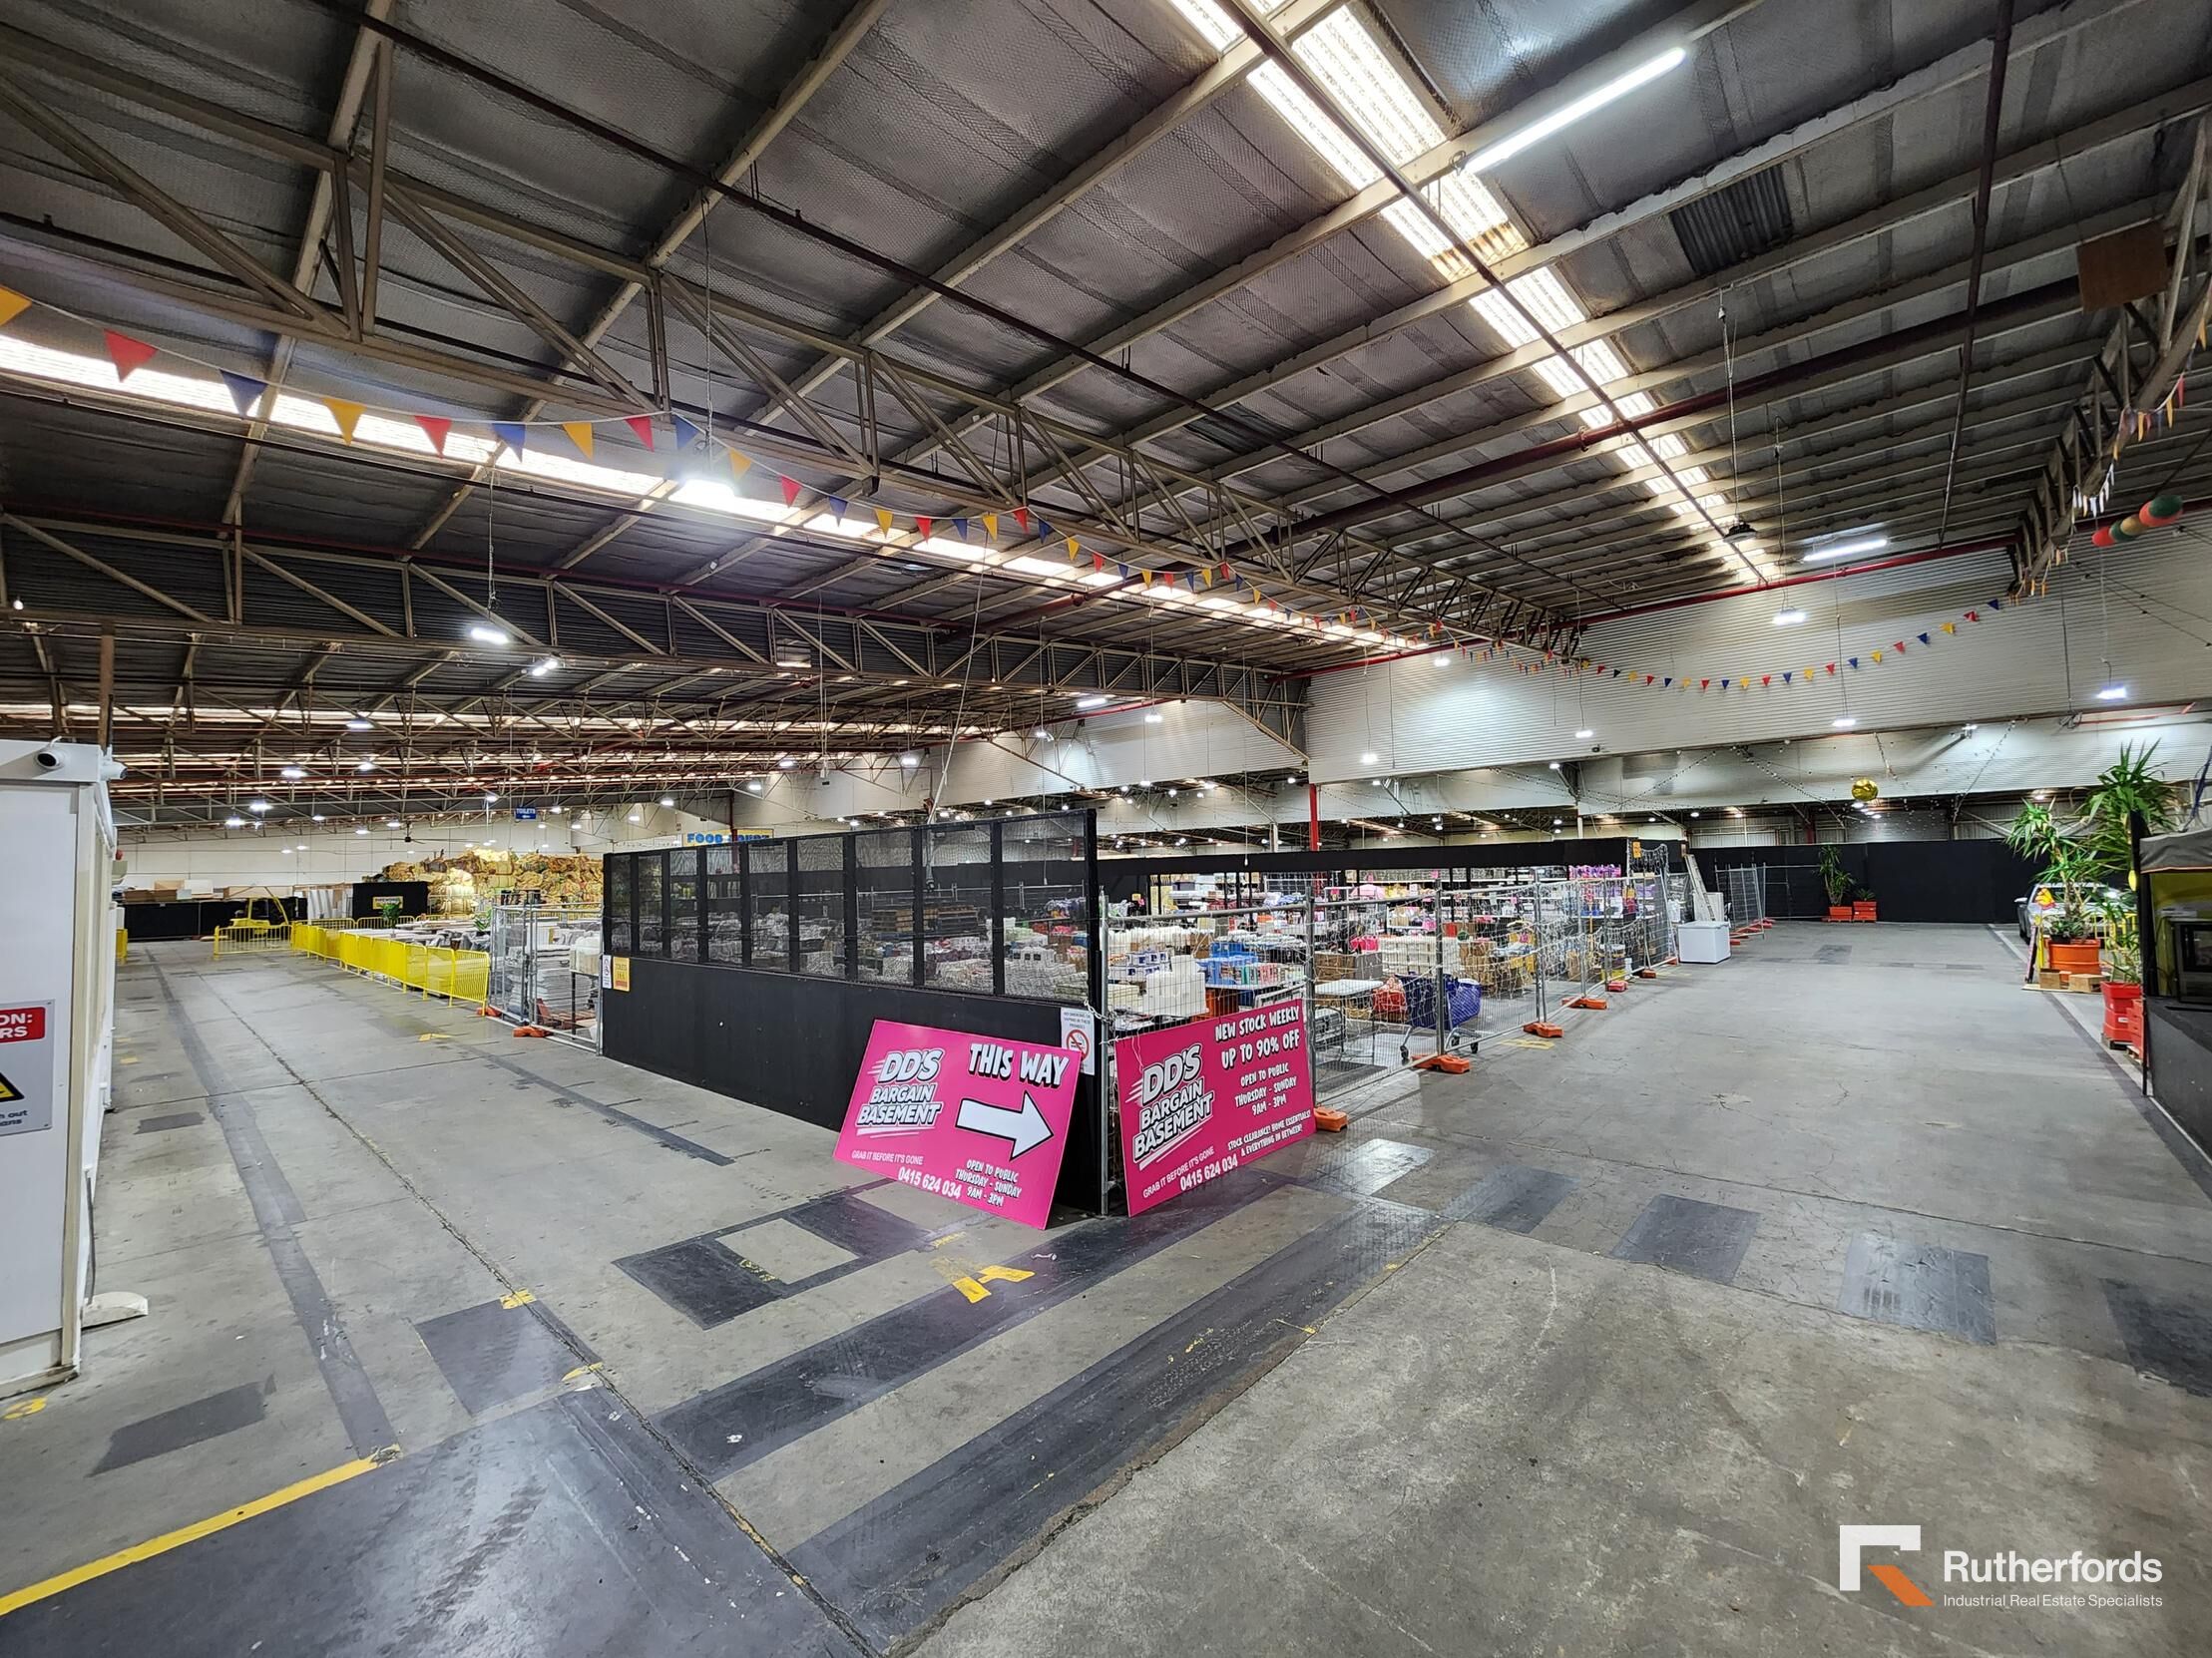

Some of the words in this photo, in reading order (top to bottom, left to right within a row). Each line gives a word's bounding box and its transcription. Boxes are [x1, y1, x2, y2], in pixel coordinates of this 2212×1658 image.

[686, 832, 723, 844] FOOD
[1215, 1022, 1236, 1042] NEW
[1239, 1014, 1266, 1036] STOCK
[1269, 1006, 1300, 1028] WEEKLY
[1221, 1047, 1236, 1069] UP
[1240, 1043, 1253, 1064] TO
[1256, 1036, 1279, 1059] 90%
[1282, 1029, 1300, 1050] OFF
[877, 1048, 945, 1083] DD'S
[968, 1042, 1015, 1080] THIS
[1020, 1050, 1070, 1089] WAY
[1141, 1043, 1202, 1106] DD'S
[1240, 1071, 1257, 1087] OPEN
[1258, 1069, 1267, 1082] TO
[1267, 1062, 1289, 1078] PUBLIC
[869, 1084, 936, 1104] BARGAIN
[1139, 1077, 1203, 1132] BARGAIN
[1234, 1086, 1267, 1107] THURSDAY
[1273, 1076, 1297, 1094] SUNDAY
[1251, 1100, 1267, 1116] 9AM
[1272, 1093, 1287, 1108] 3PM
[857, 1103, 942, 1125] BASEMENT
[1133, 1092, 1213, 1161] BASEMENT
[1227, 1137, 1243, 1151] STOCK
[1243, 1125, 1272, 1143] CLEARANCE!
[1271, 1120, 1285, 1132] HOME
[1246, 1135, 1275, 1154] EVERYTHING
[1274, 1133, 1281, 1142] IN
[851, 1150, 867, 1160] GRAB
[872, 1152, 894, 1163] BEFORE
[894, 1154, 905, 1164] IT'S
[905, 1155, 924, 1165] GONE
[966, 1159, 984, 1172] OPEN
[985, 1164, 994, 1176] TO
[994, 1167, 1019, 1184] PUBLIC
[1142, 1181, 1160, 1198] GRAB
[1159, 1177, 1166, 1188] IT
[1166, 1164, 1189, 1183] BEFORE
[1188, 1157, 1199, 1168] IT'S
[1198, 1145, 1214, 1162] GONE
[1179, 1169, 1203, 1191] 0415
[1203, 1160, 1221, 1180] 624
[1222, 1153, 1238, 1172] 034
[898, 1165, 922, 1186] 0415
[922, 1173, 942, 1193] 624
[942, 1180, 962, 1199] 034
[955, 1168, 989, 1188] THURSDAY
[994, 1182, 1022, 1199] SUNDAY
[967, 1186, 983, 1201] 9AM
[987, 1193, 1005, 1207] 3PM
